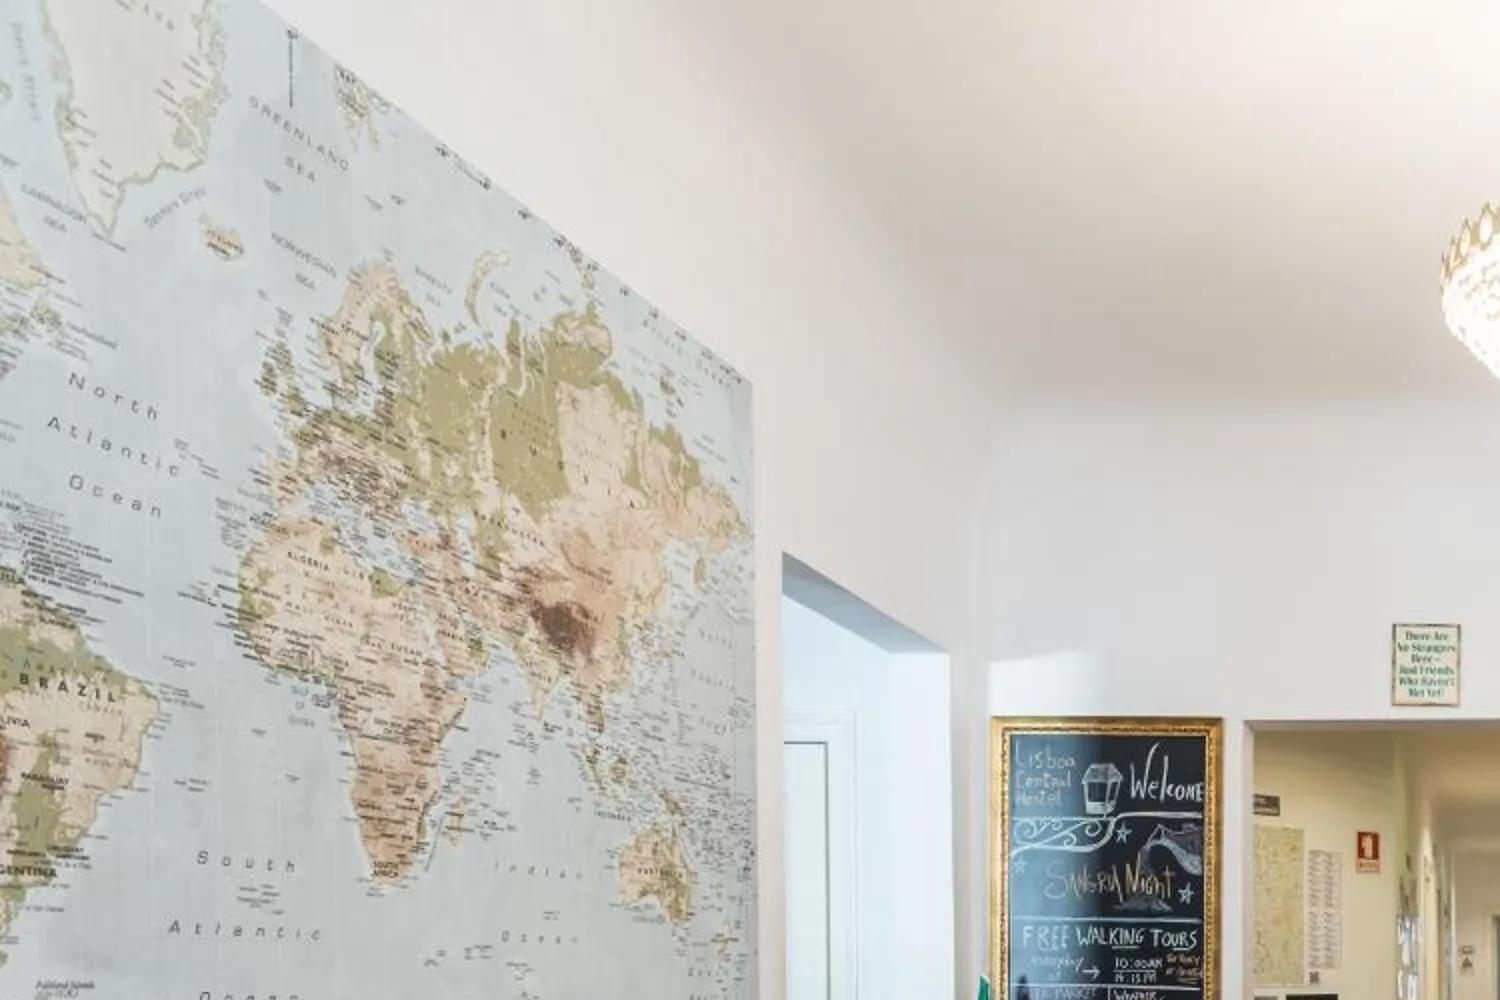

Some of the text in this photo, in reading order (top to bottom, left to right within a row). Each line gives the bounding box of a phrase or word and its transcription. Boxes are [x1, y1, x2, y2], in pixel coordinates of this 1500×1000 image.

[68, 371, 158, 420] North
[47, 416, 179, 478] Atlantic
[68, 474, 162, 519] Ocean
[286, 551, 330, 571] ALGERIA
[19, 672, 117, 703] BRAZIL
[196, 850, 296, 874] South
[168, 920, 321, 942] Atlantic
[1022, 925, 1070, 950] FREE
[1075, 925, 1145, 948] WALKING
